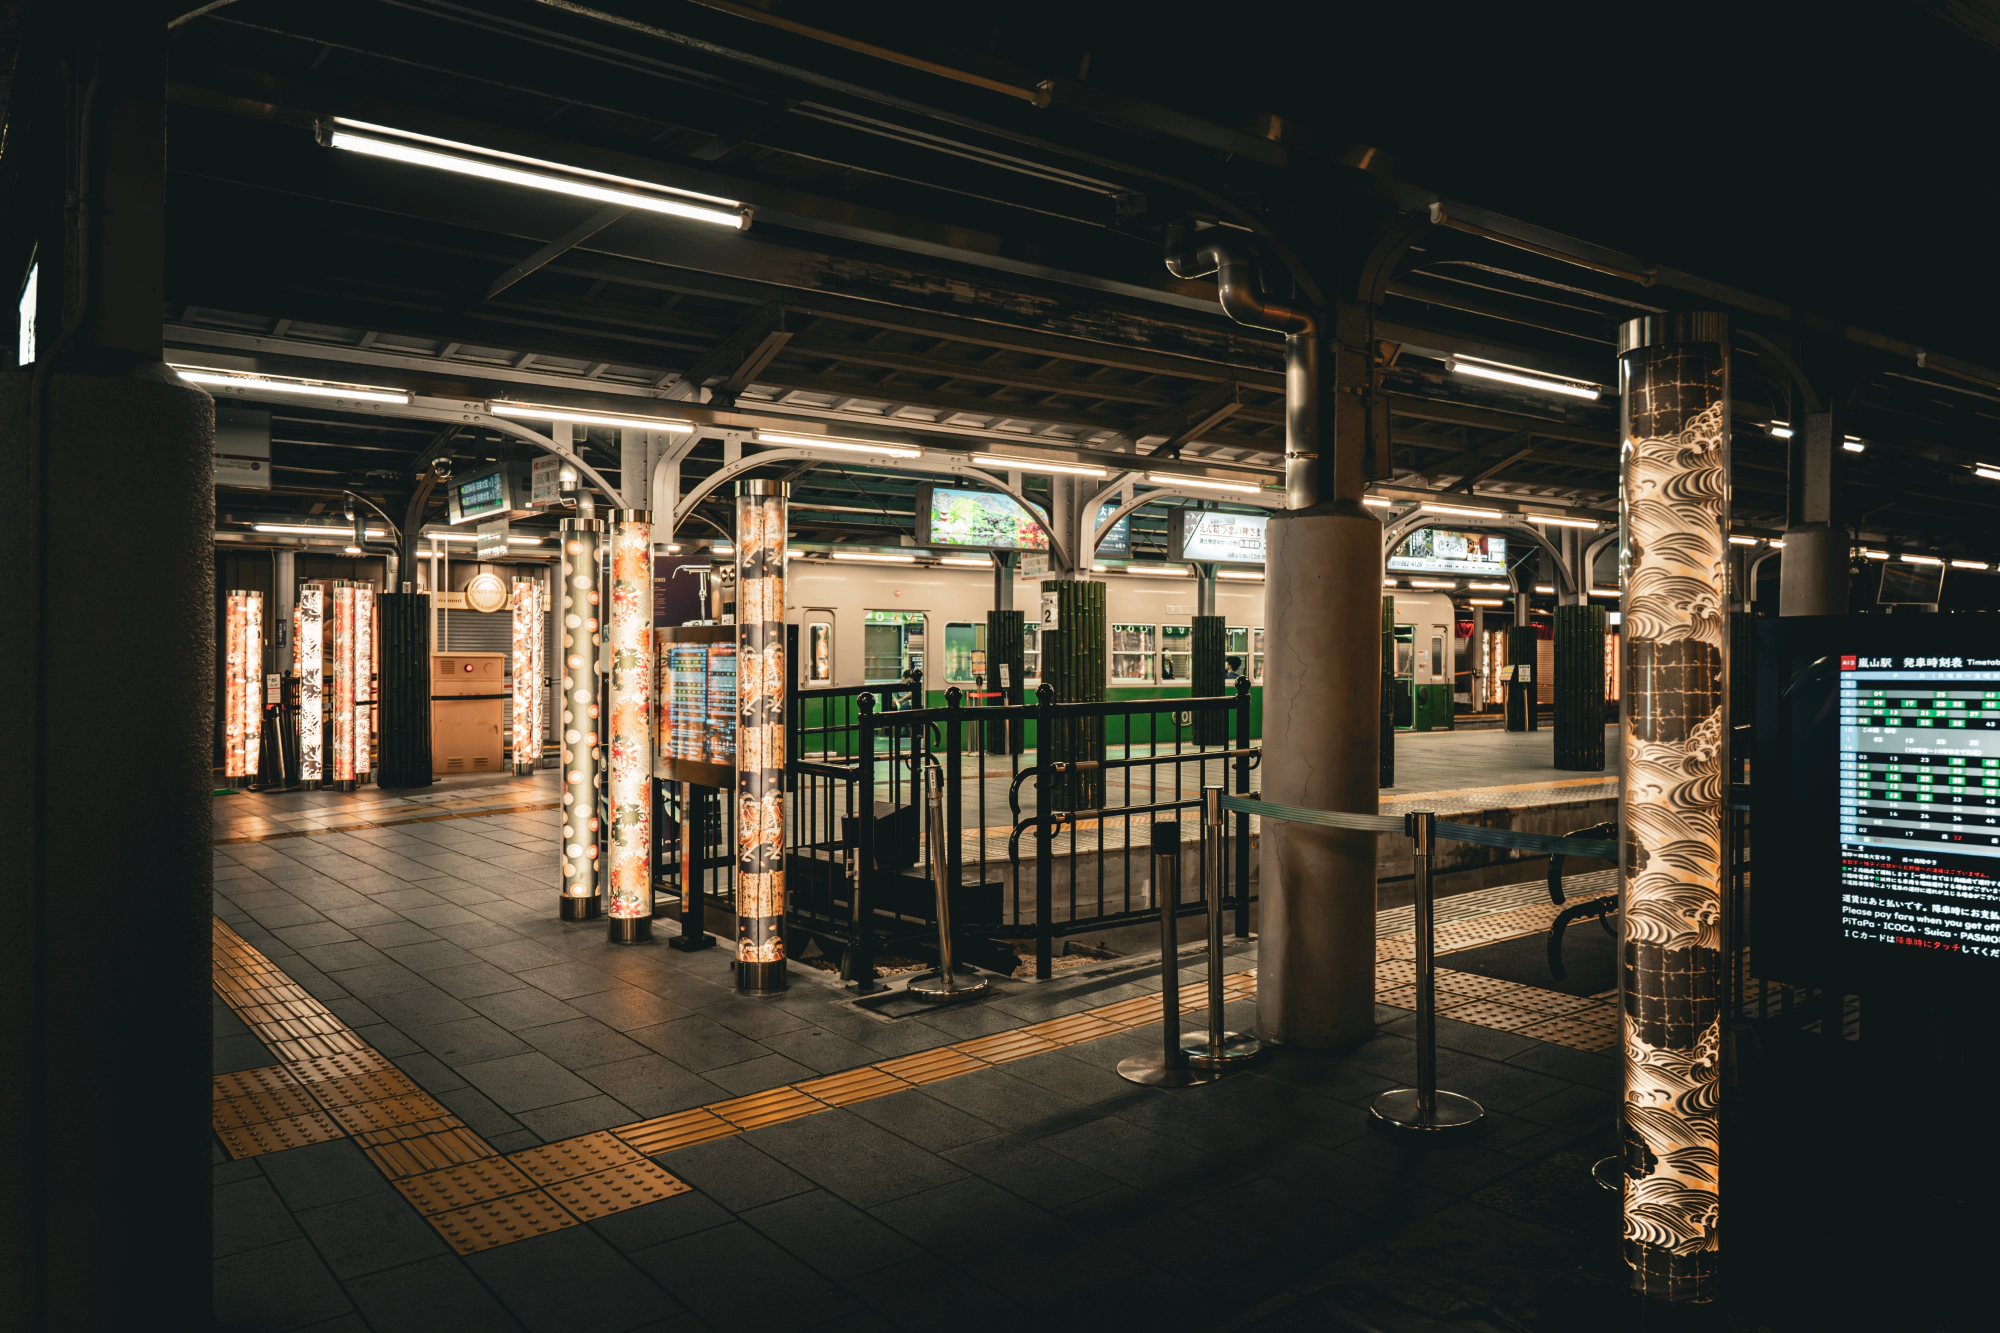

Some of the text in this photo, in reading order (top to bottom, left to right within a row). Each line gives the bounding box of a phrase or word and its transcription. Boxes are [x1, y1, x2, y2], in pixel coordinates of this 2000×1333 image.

[1044, 610, 1051, 622] 2
[1858, 658, 1892, 668] 嵐山駅
[1903, 658, 1963, 668] 発車時刻表
[1842, 906, 1872, 916] Please
[1874, 911, 1892, 920] pay
[1894, 912, 1914, 921] fare
[1916, 916, 1942, 924] when
[1965, 922, 1982, 930] get
[1960, 932, 2000, 944] PASMO
